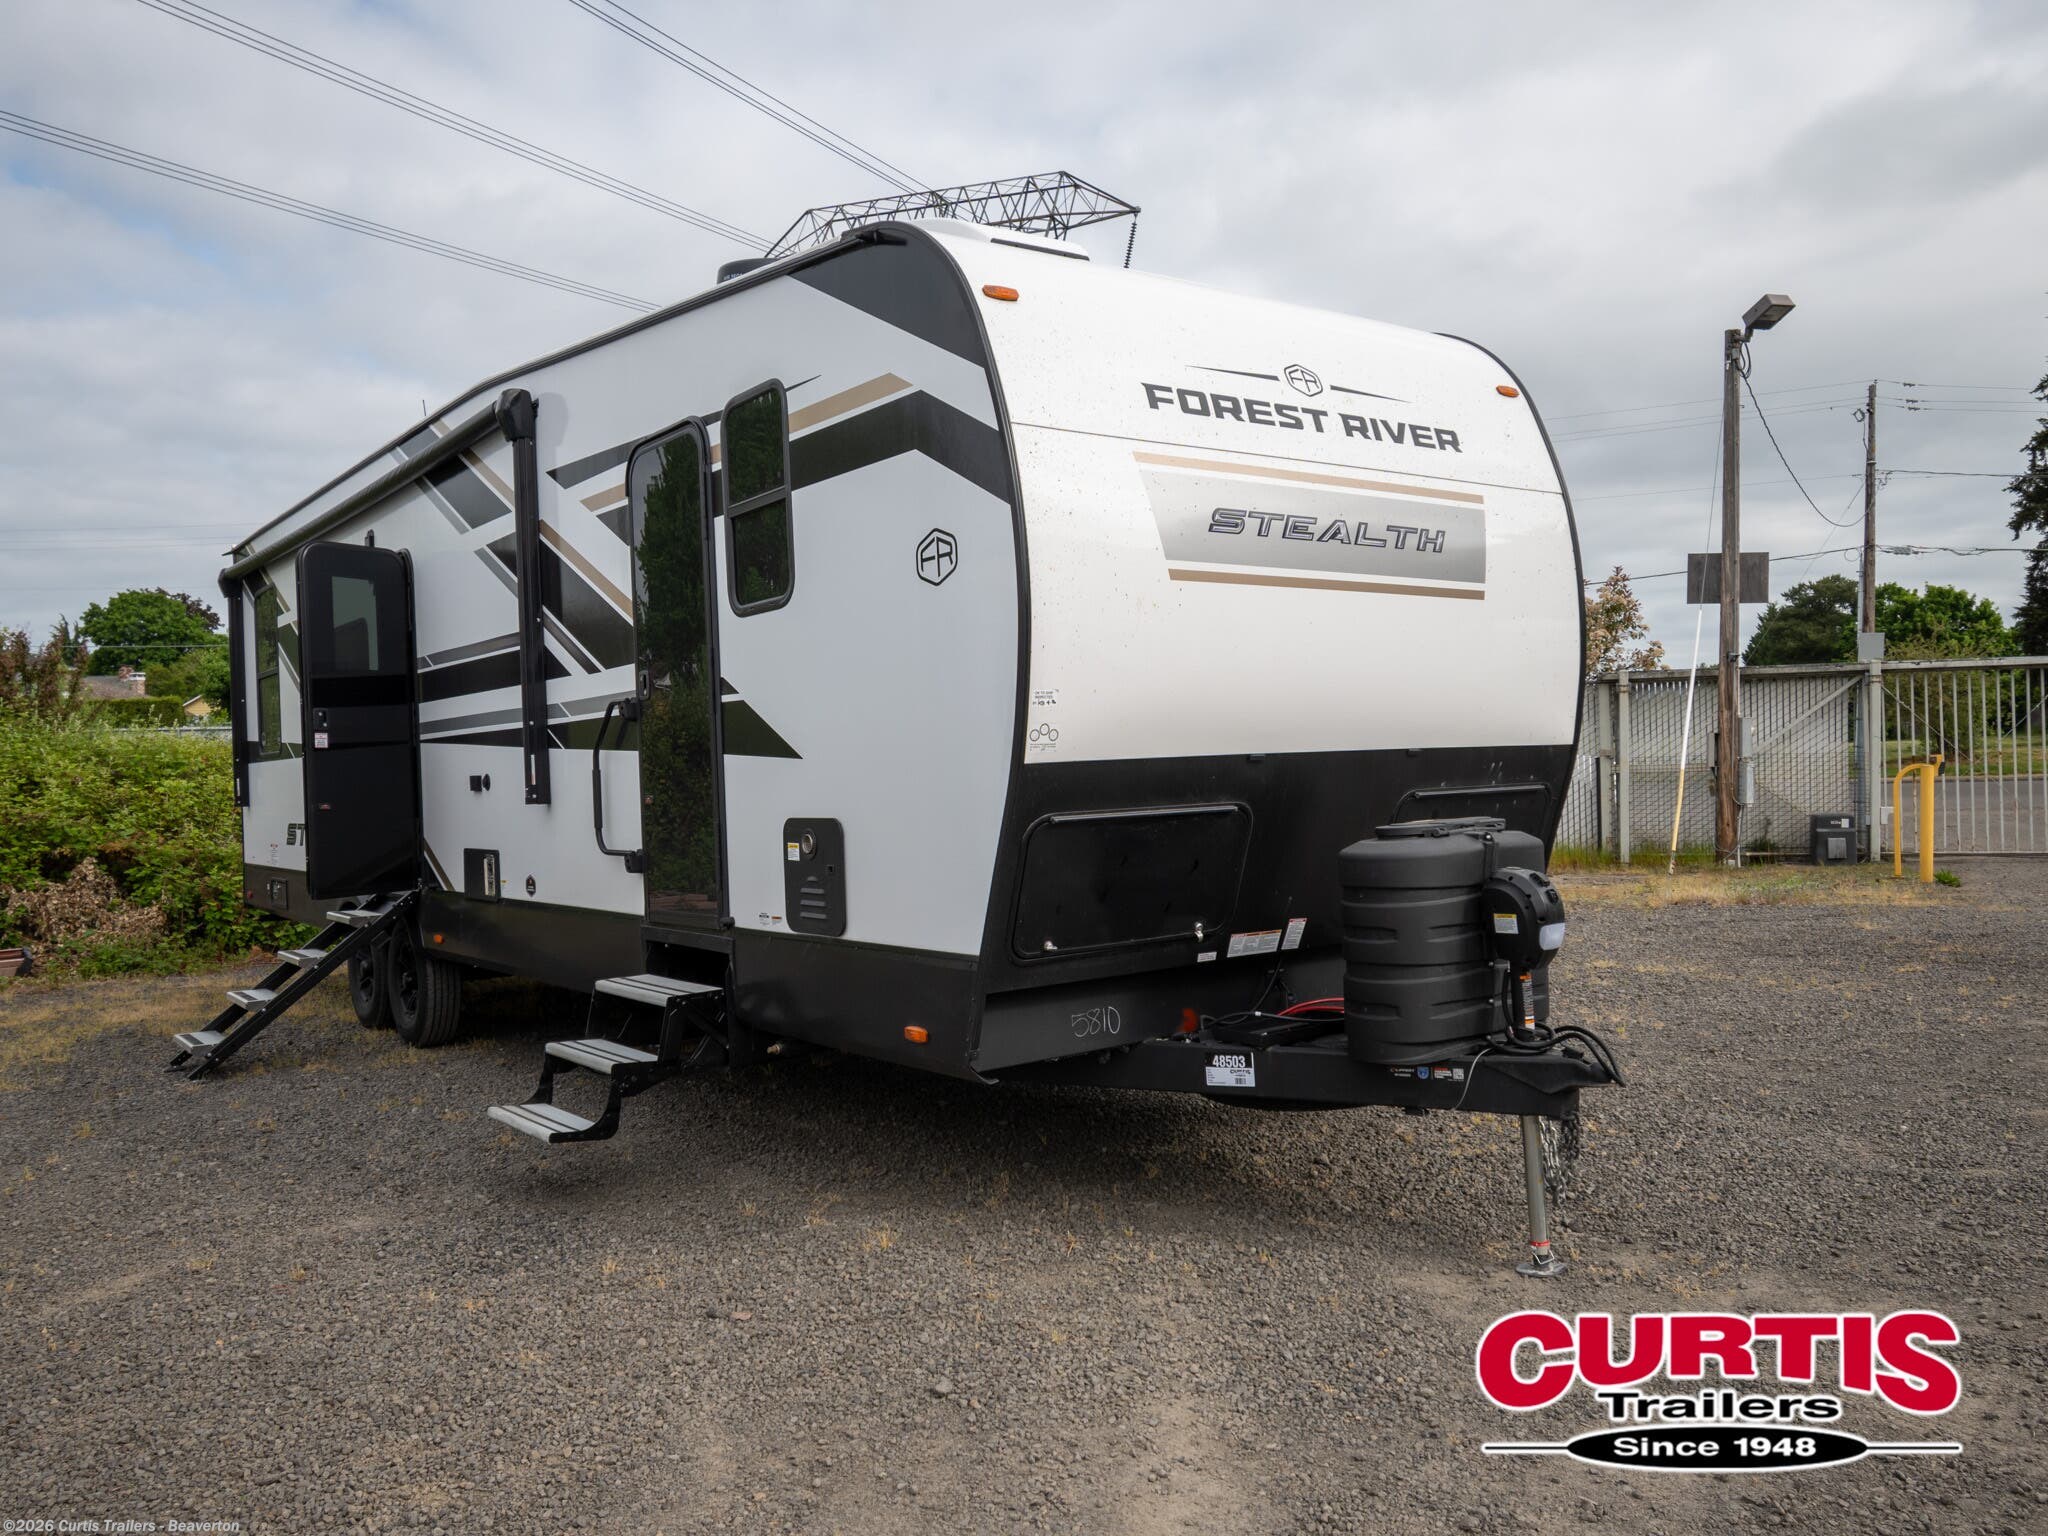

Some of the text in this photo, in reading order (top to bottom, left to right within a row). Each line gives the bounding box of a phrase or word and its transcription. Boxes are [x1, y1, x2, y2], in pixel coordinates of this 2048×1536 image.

[1140, 382, 1463, 453] FOREST RIVER
[1208, 507, 1446, 553] STEALTH
[1071, 1006, 1121, 1038] 5810
[1212, 1054, 1246, 1068] 48503
